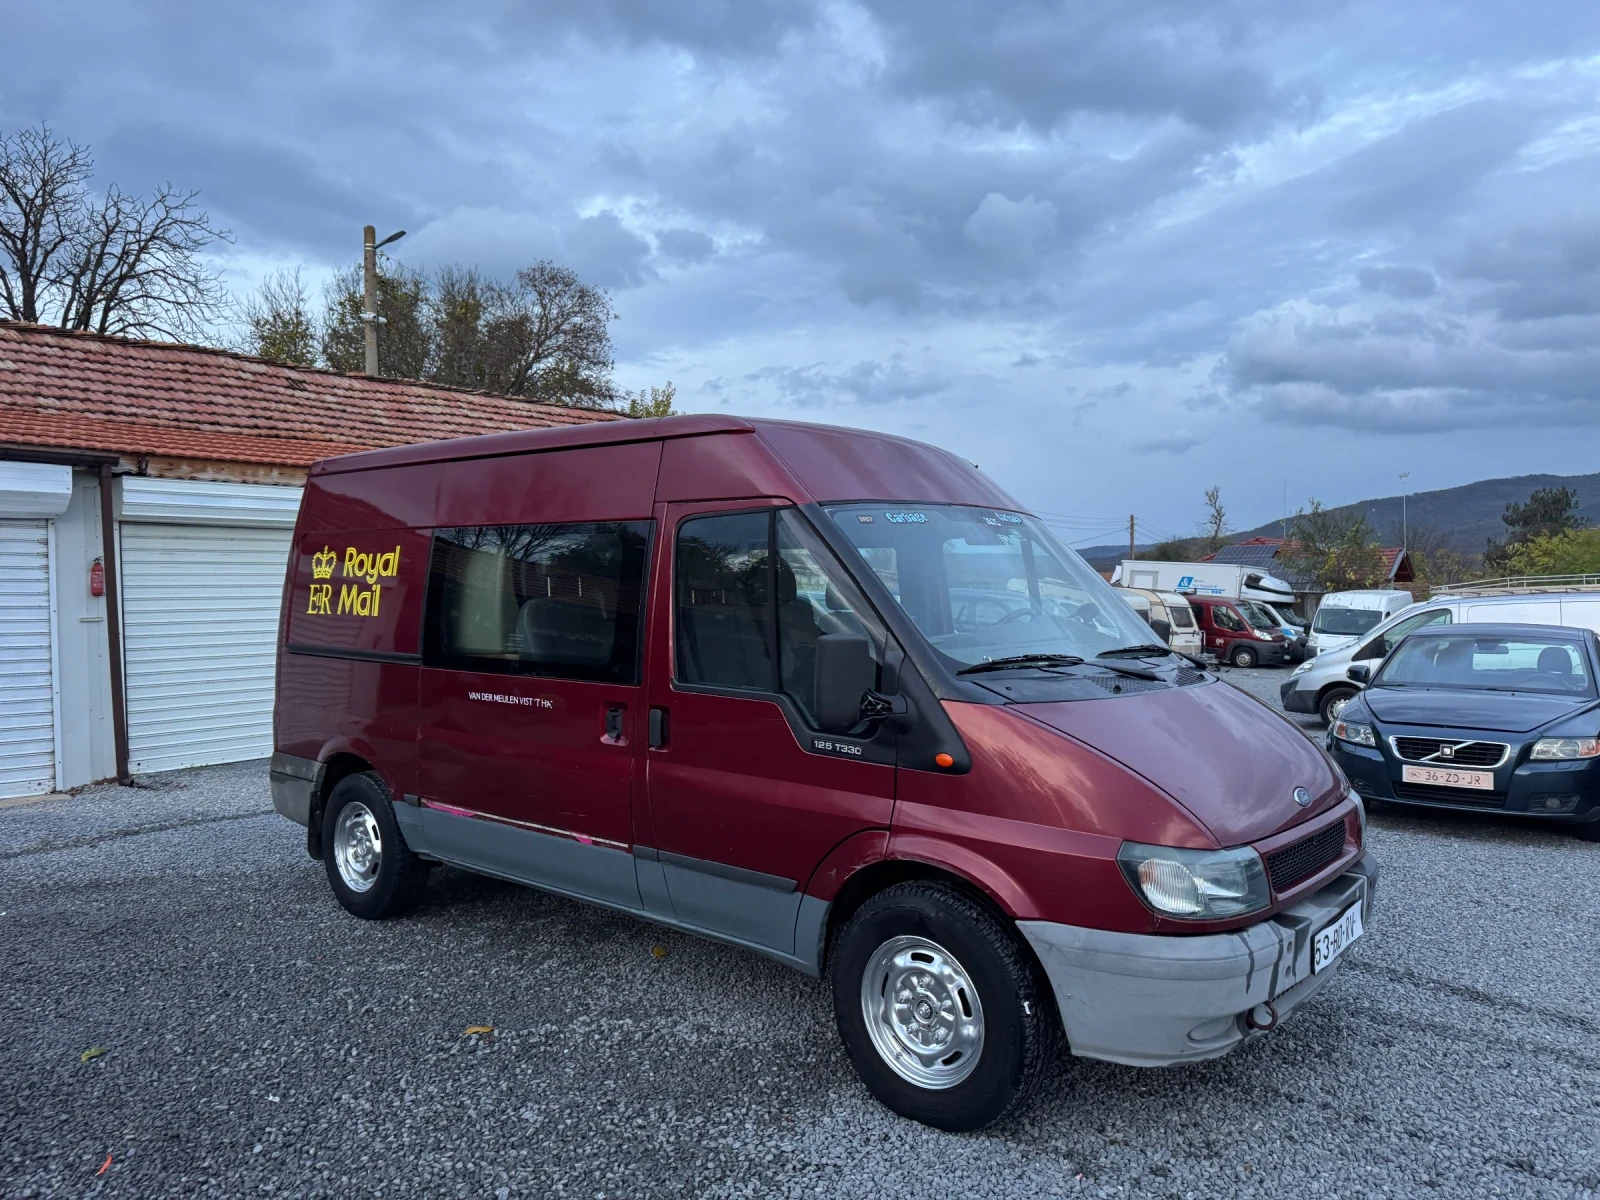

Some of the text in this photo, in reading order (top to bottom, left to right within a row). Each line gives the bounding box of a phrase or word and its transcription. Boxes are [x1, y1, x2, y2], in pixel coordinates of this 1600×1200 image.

[342, 545, 401, 584] Royal
[336, 583, 381, 617] Mail
[468, 691, 481, 700] VAN
[481, 693, 493, 702] DER
[493, 694, 519, 705] MEULEN
[519, 696, 534, 707] VIST
[814, 740, 862, 756] 125 T330
[1425, 771, 1482, 785] 36-ZD-JR
